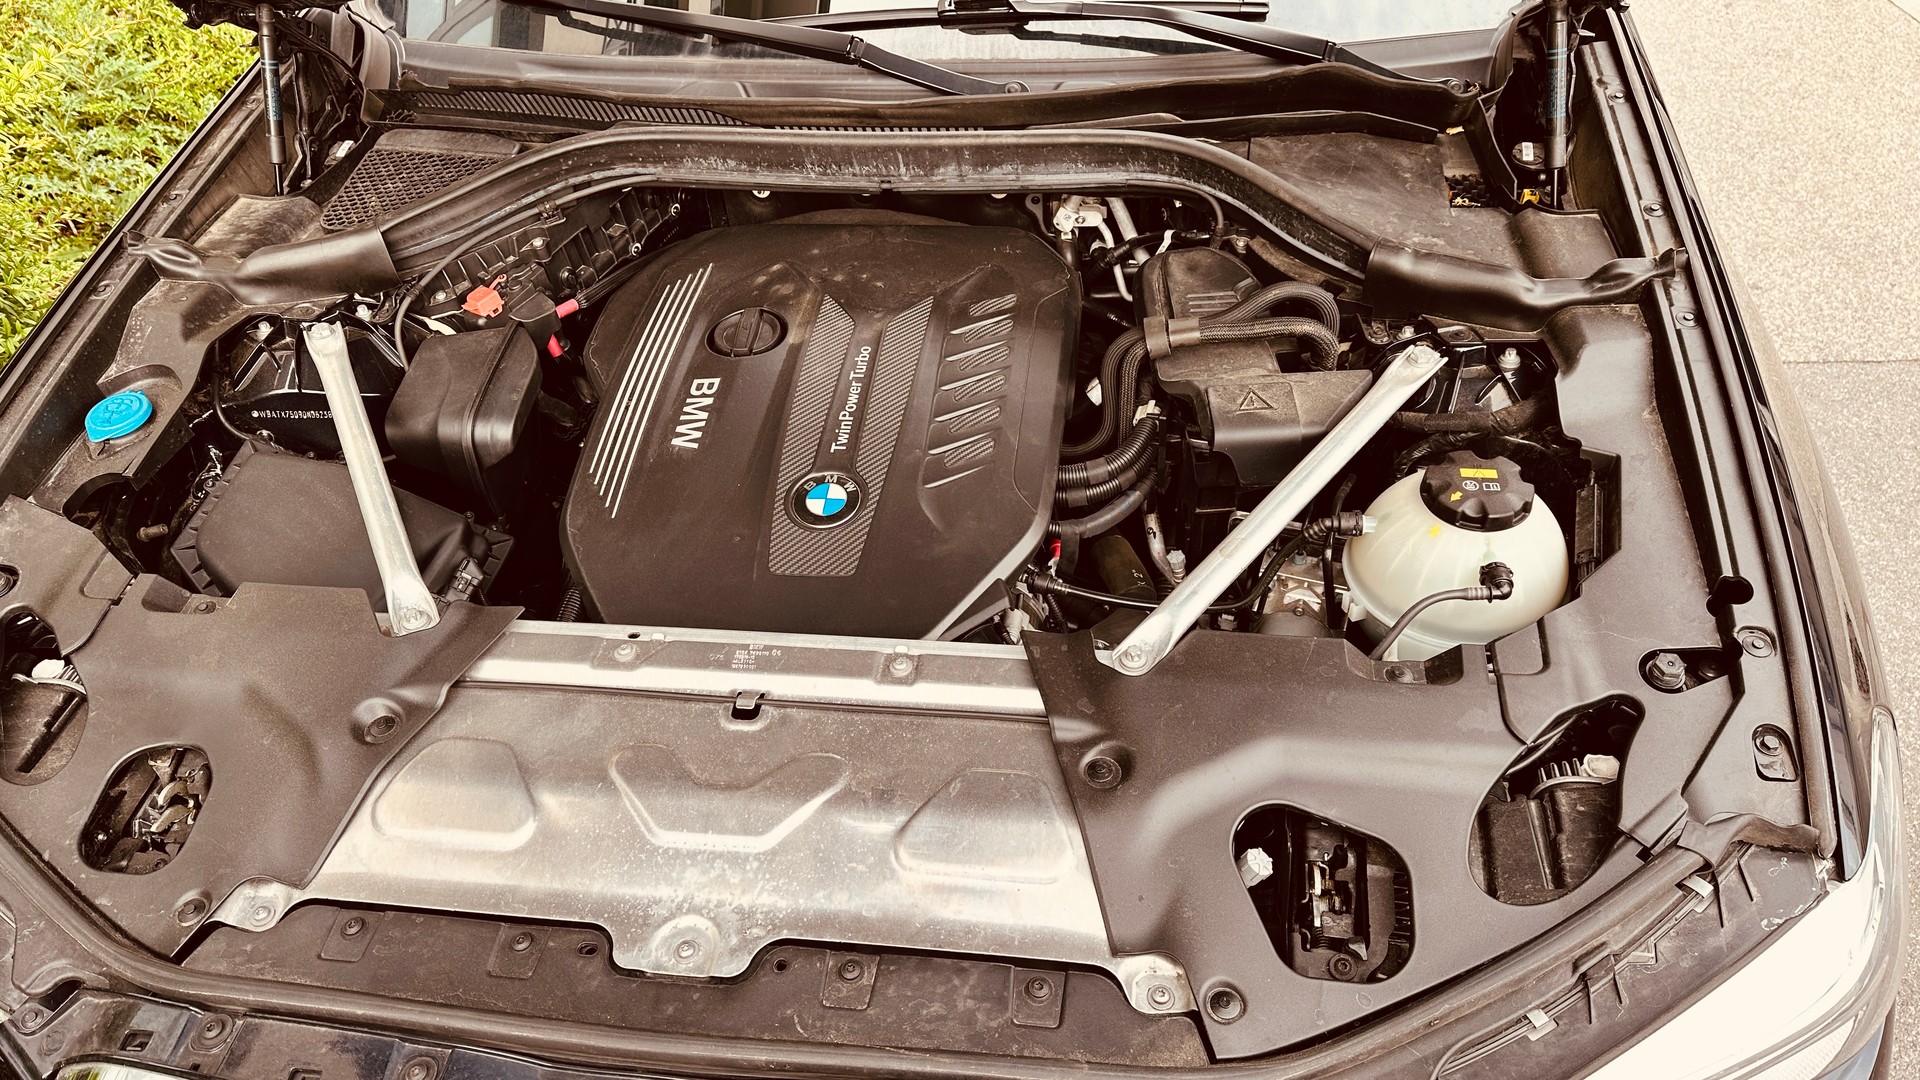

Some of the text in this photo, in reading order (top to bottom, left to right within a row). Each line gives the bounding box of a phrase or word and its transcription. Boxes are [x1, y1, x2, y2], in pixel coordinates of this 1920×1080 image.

[671, 377, 721, 449] BMW
[830, 346, 871, 453] TwinPower Turbo
[804, 474, 857, 492] BMW
